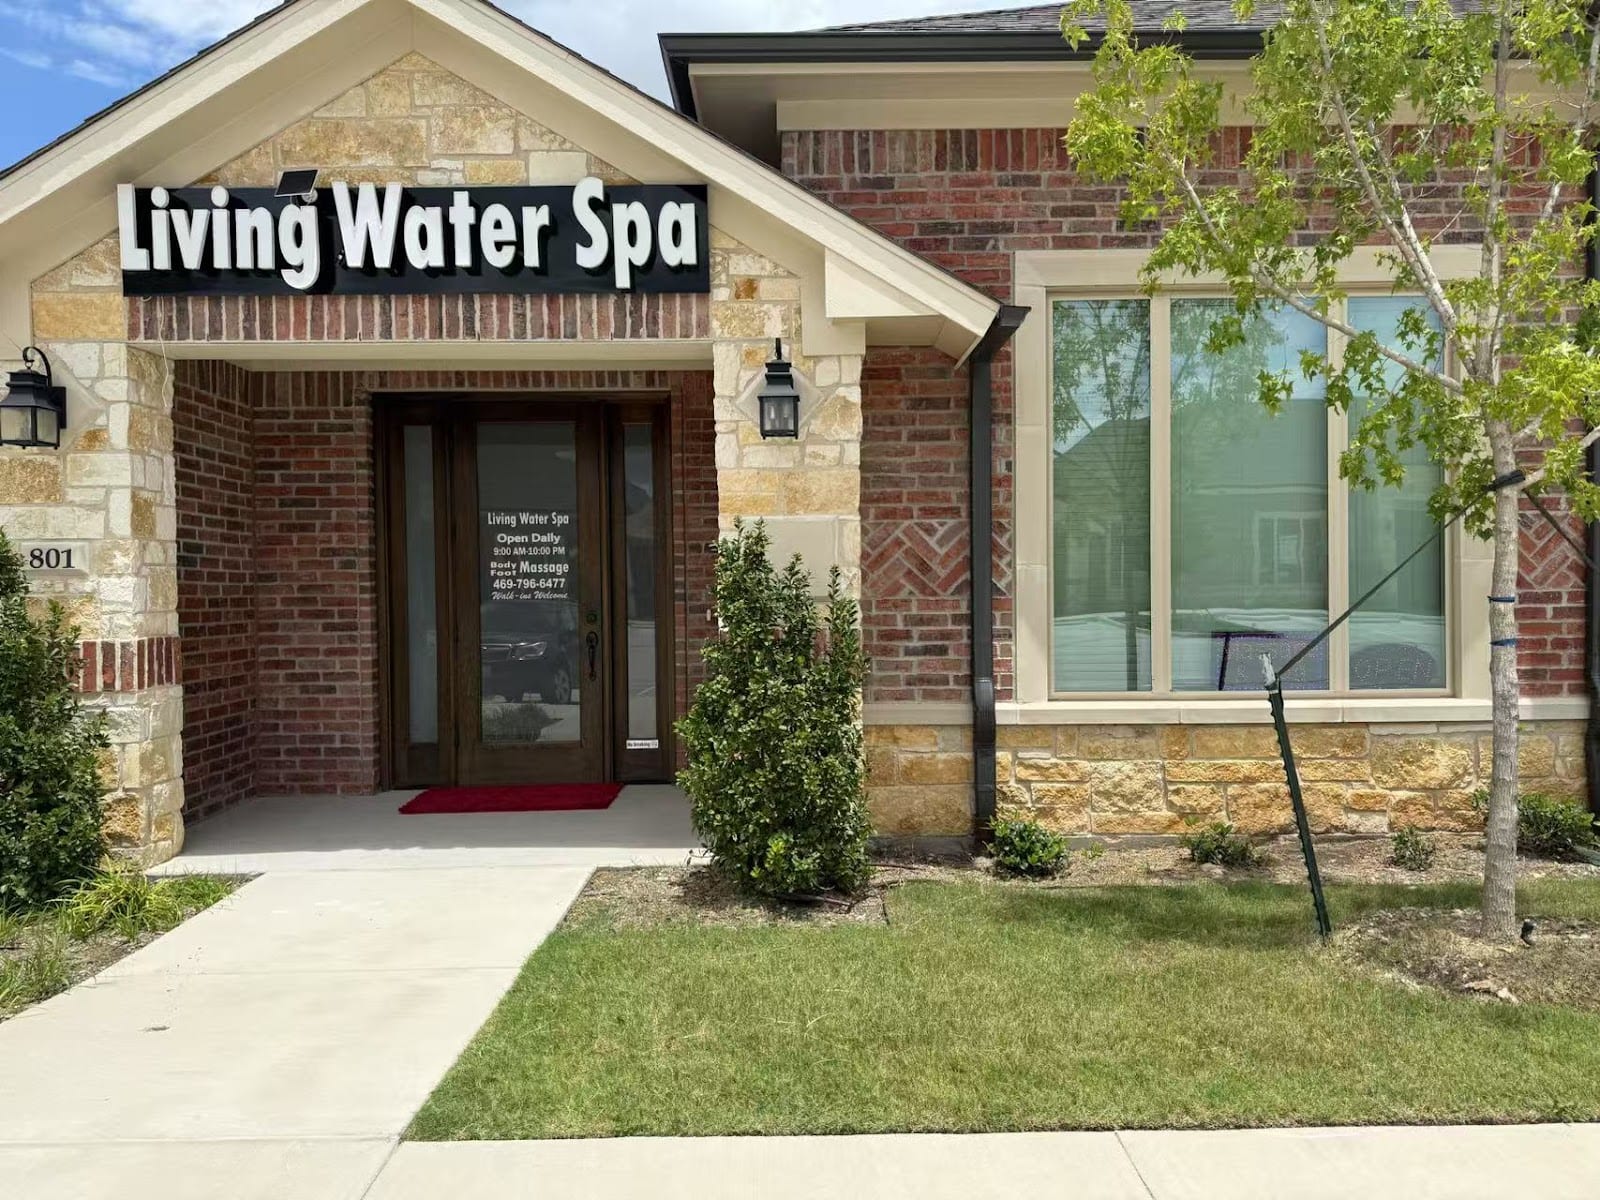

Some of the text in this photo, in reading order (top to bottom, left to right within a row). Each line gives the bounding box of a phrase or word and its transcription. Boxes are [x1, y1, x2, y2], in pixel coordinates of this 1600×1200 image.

[117, 176, 698, 289] Living Water Spa
[487, 511, 569, 528] Living Water Spa
[497, 532, 561, 545] Open Daily
[493, 547, 512, 556] 9:00
[552, 546, 566, 556] PM
[29, 548, 76, 569] 801
[490, 560, 570, 576] Body Massage
[490, 569, 517, 577] Foot
[493, 578, 566, 590] 469-796-6477
[533, 590, 569, 600] Welcome
[1354, 658, 1434, 682] OPEN
